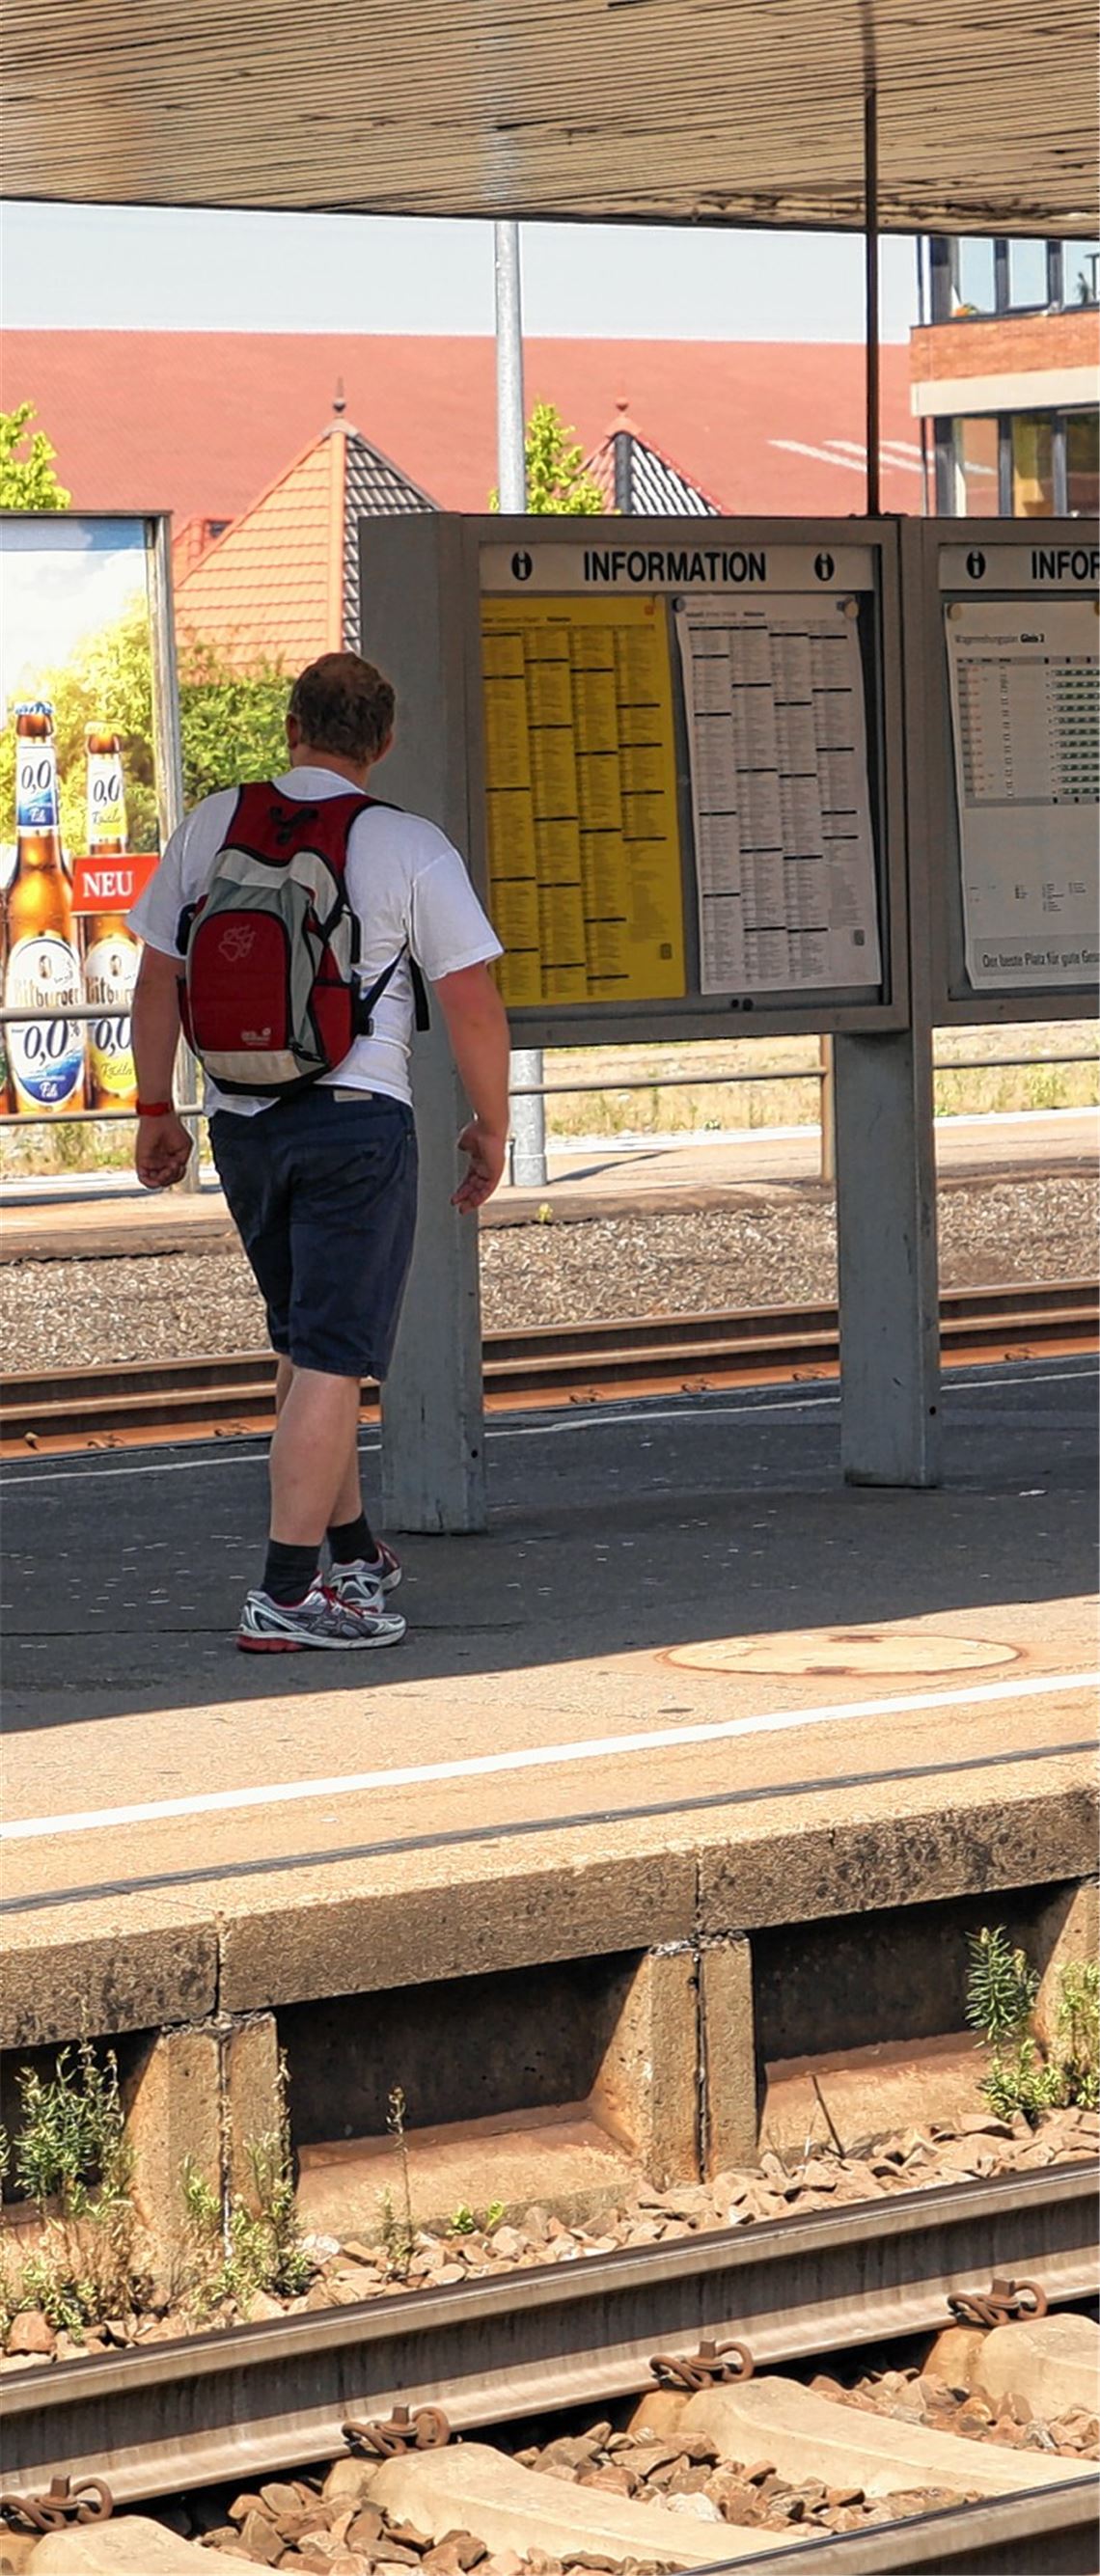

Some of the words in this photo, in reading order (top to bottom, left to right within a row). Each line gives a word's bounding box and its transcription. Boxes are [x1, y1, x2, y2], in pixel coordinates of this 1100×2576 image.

[583, 550, 766, 582] INFORMATION
[21, 759, 52, 794] 0,0
[82, 870, 133, 898] NEU
